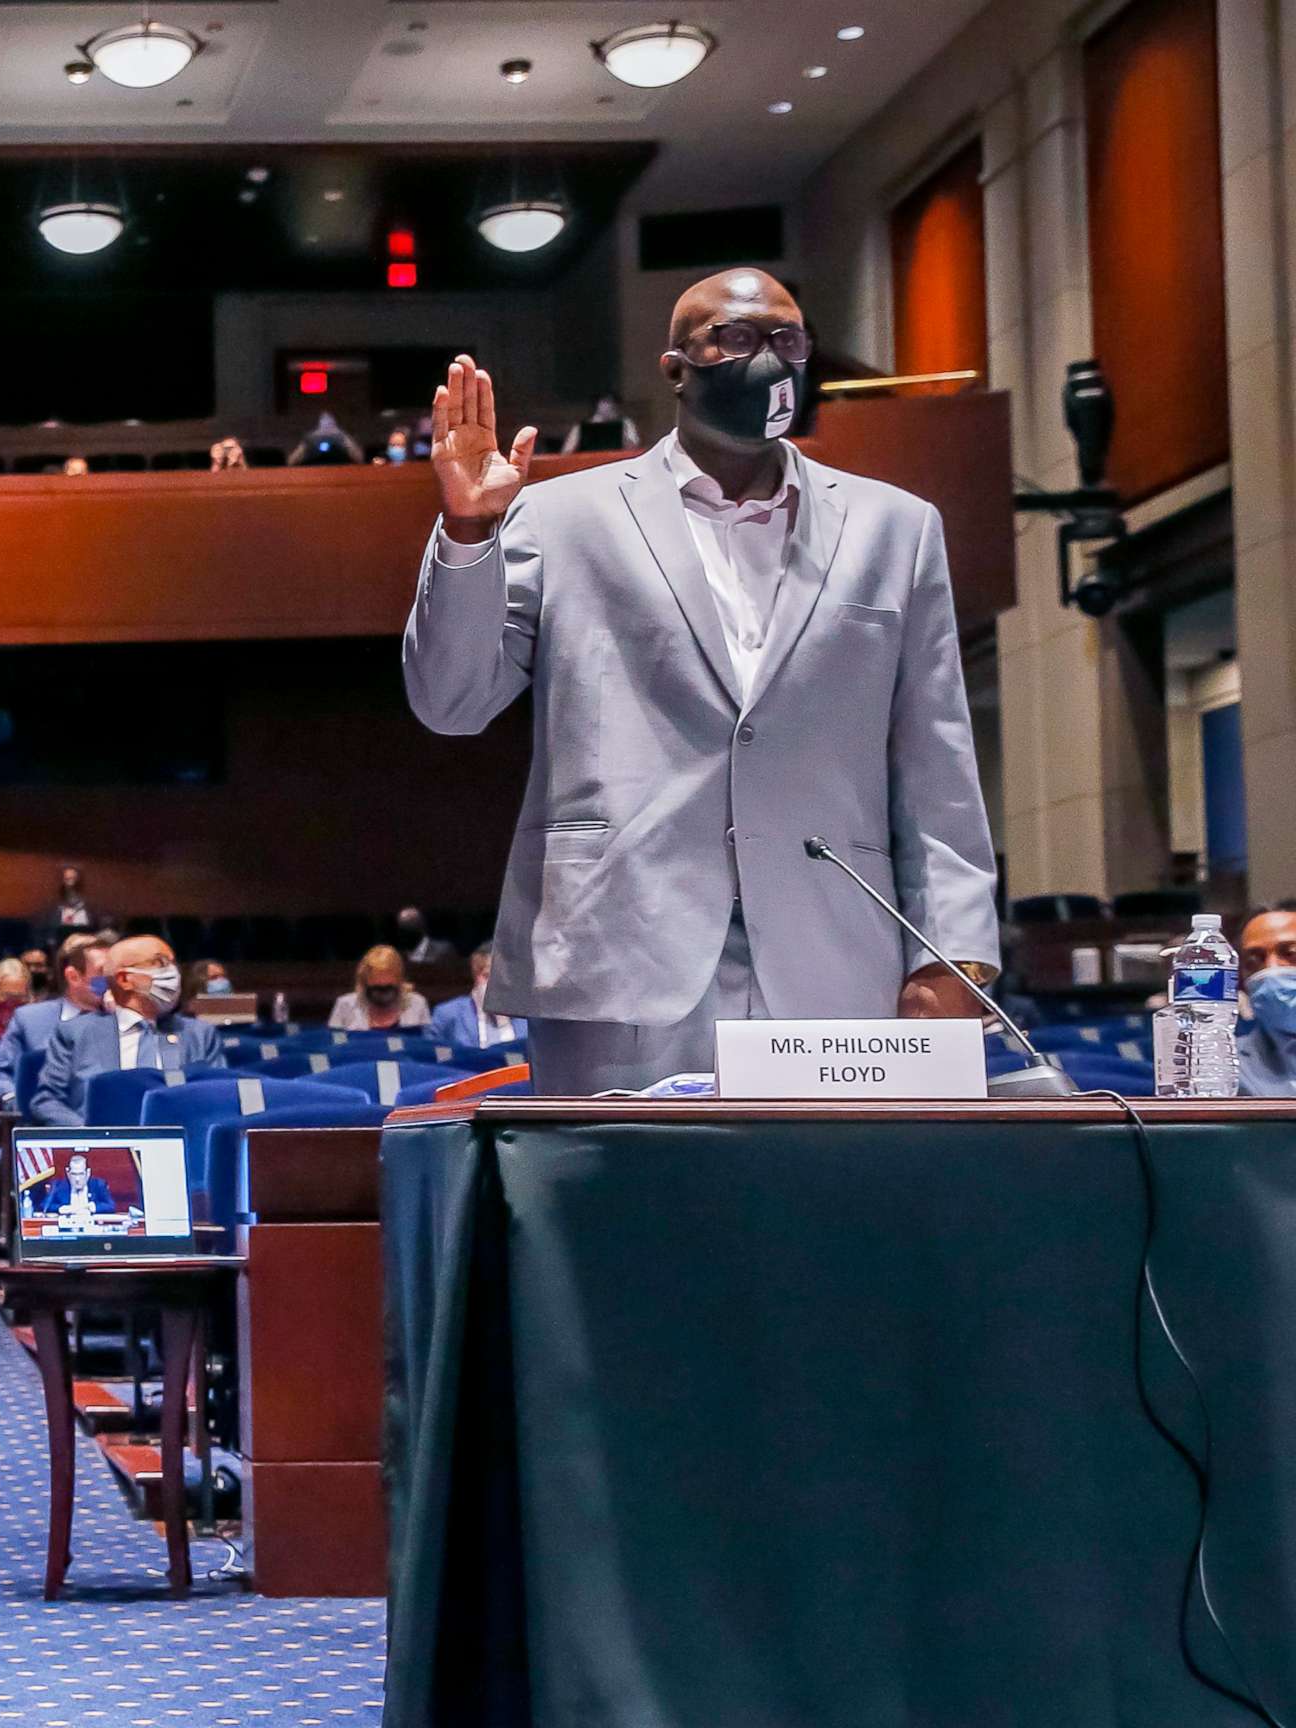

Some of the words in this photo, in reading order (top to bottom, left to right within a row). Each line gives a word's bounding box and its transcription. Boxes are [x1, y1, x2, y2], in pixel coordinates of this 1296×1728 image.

[771, 1038, 812, 1054] MR.
[822, 1038, 931, 1054] PHILONISE
[819, 1066, 886, 1083] FLOYD
